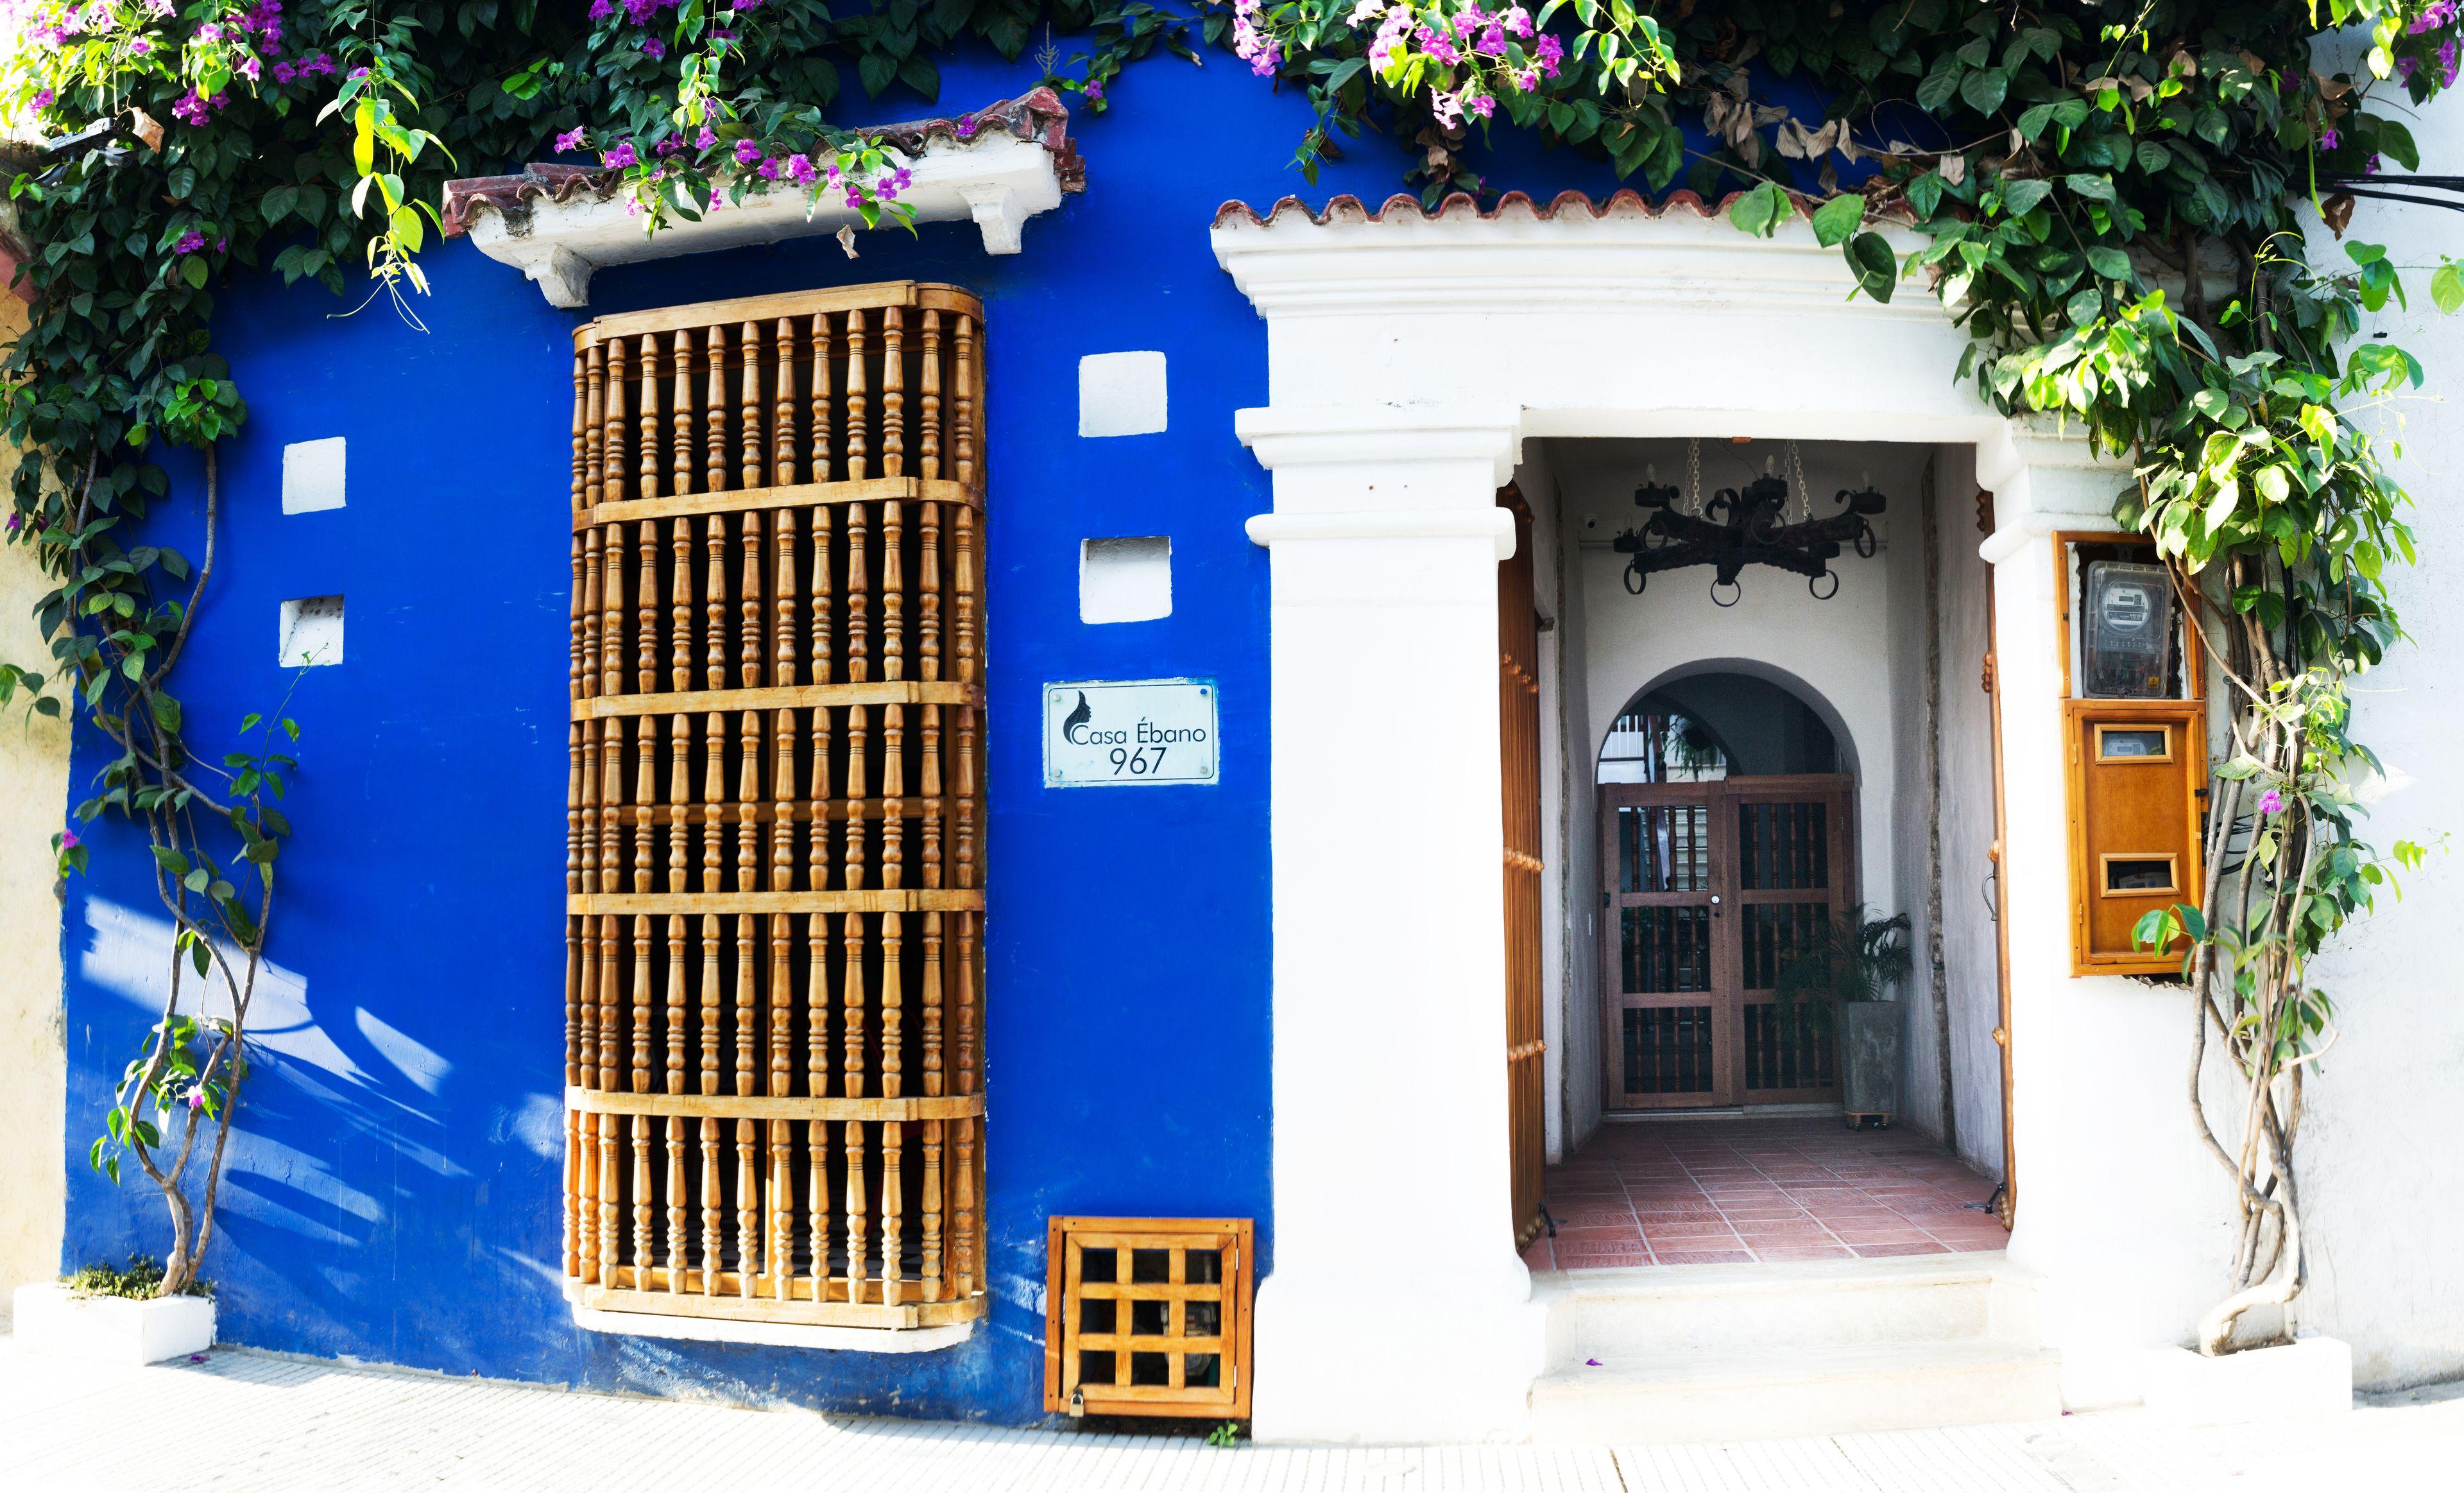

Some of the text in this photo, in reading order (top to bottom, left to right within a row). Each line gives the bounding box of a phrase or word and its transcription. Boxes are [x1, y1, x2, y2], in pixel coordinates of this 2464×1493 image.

[1072, 716, 1206, 745] Casa Ébano
[1109, 747, 1167, 775] 967
